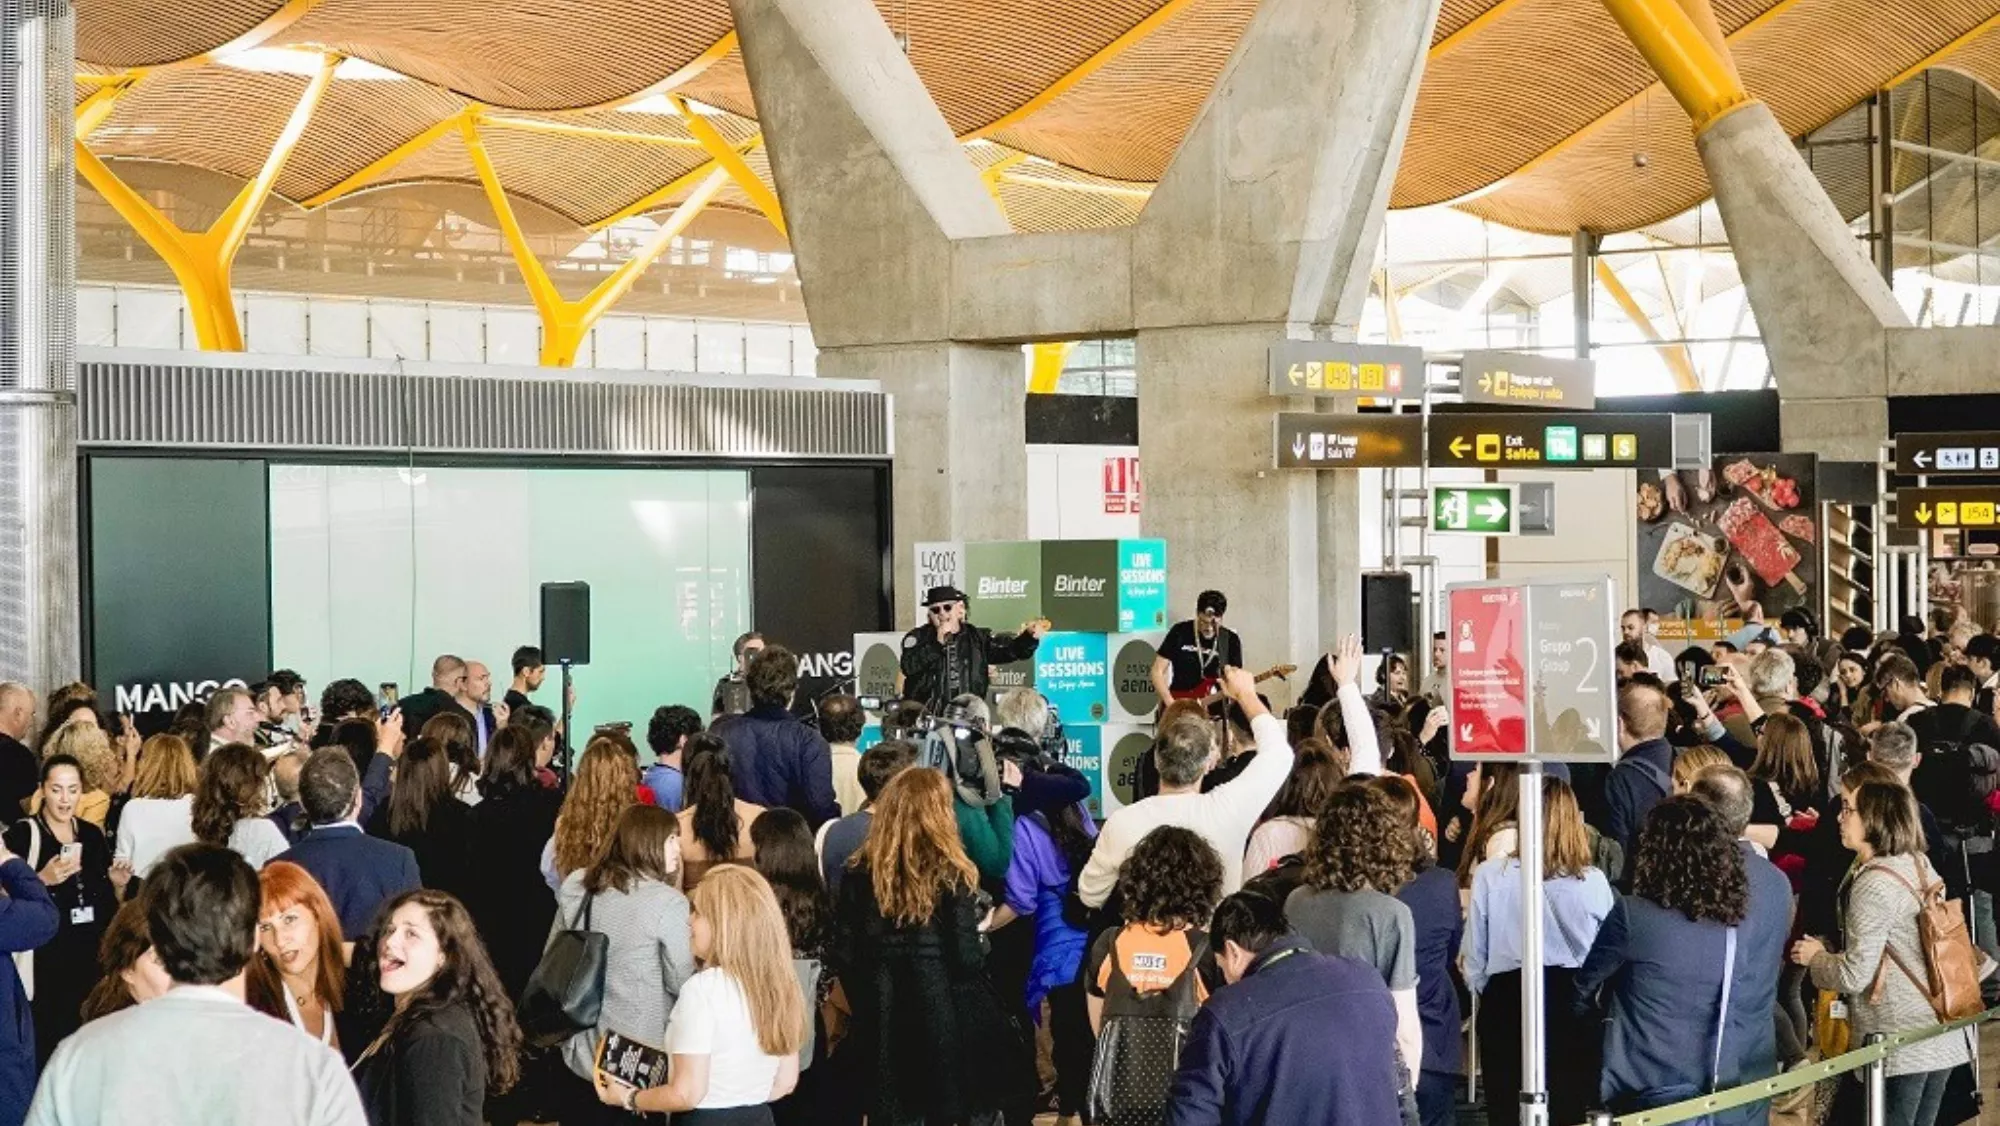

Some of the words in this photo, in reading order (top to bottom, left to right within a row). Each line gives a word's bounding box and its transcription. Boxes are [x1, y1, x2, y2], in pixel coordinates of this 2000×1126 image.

[1505, 434, 1524, 447] Exit
[1505, 447, 1540, 460] Salida
[978, 576, 1030, 595] Binter
[1053, 574, 1107, 592] Binter
[1055, 645, 1085, 661] LIVE
[1039, 661, 1105, 678] SESSIONS
[1540, 638, 1571, 656] Grupo
[1575, 636, 1599, 693] 2
[997, 668, 1027, 685] inter
